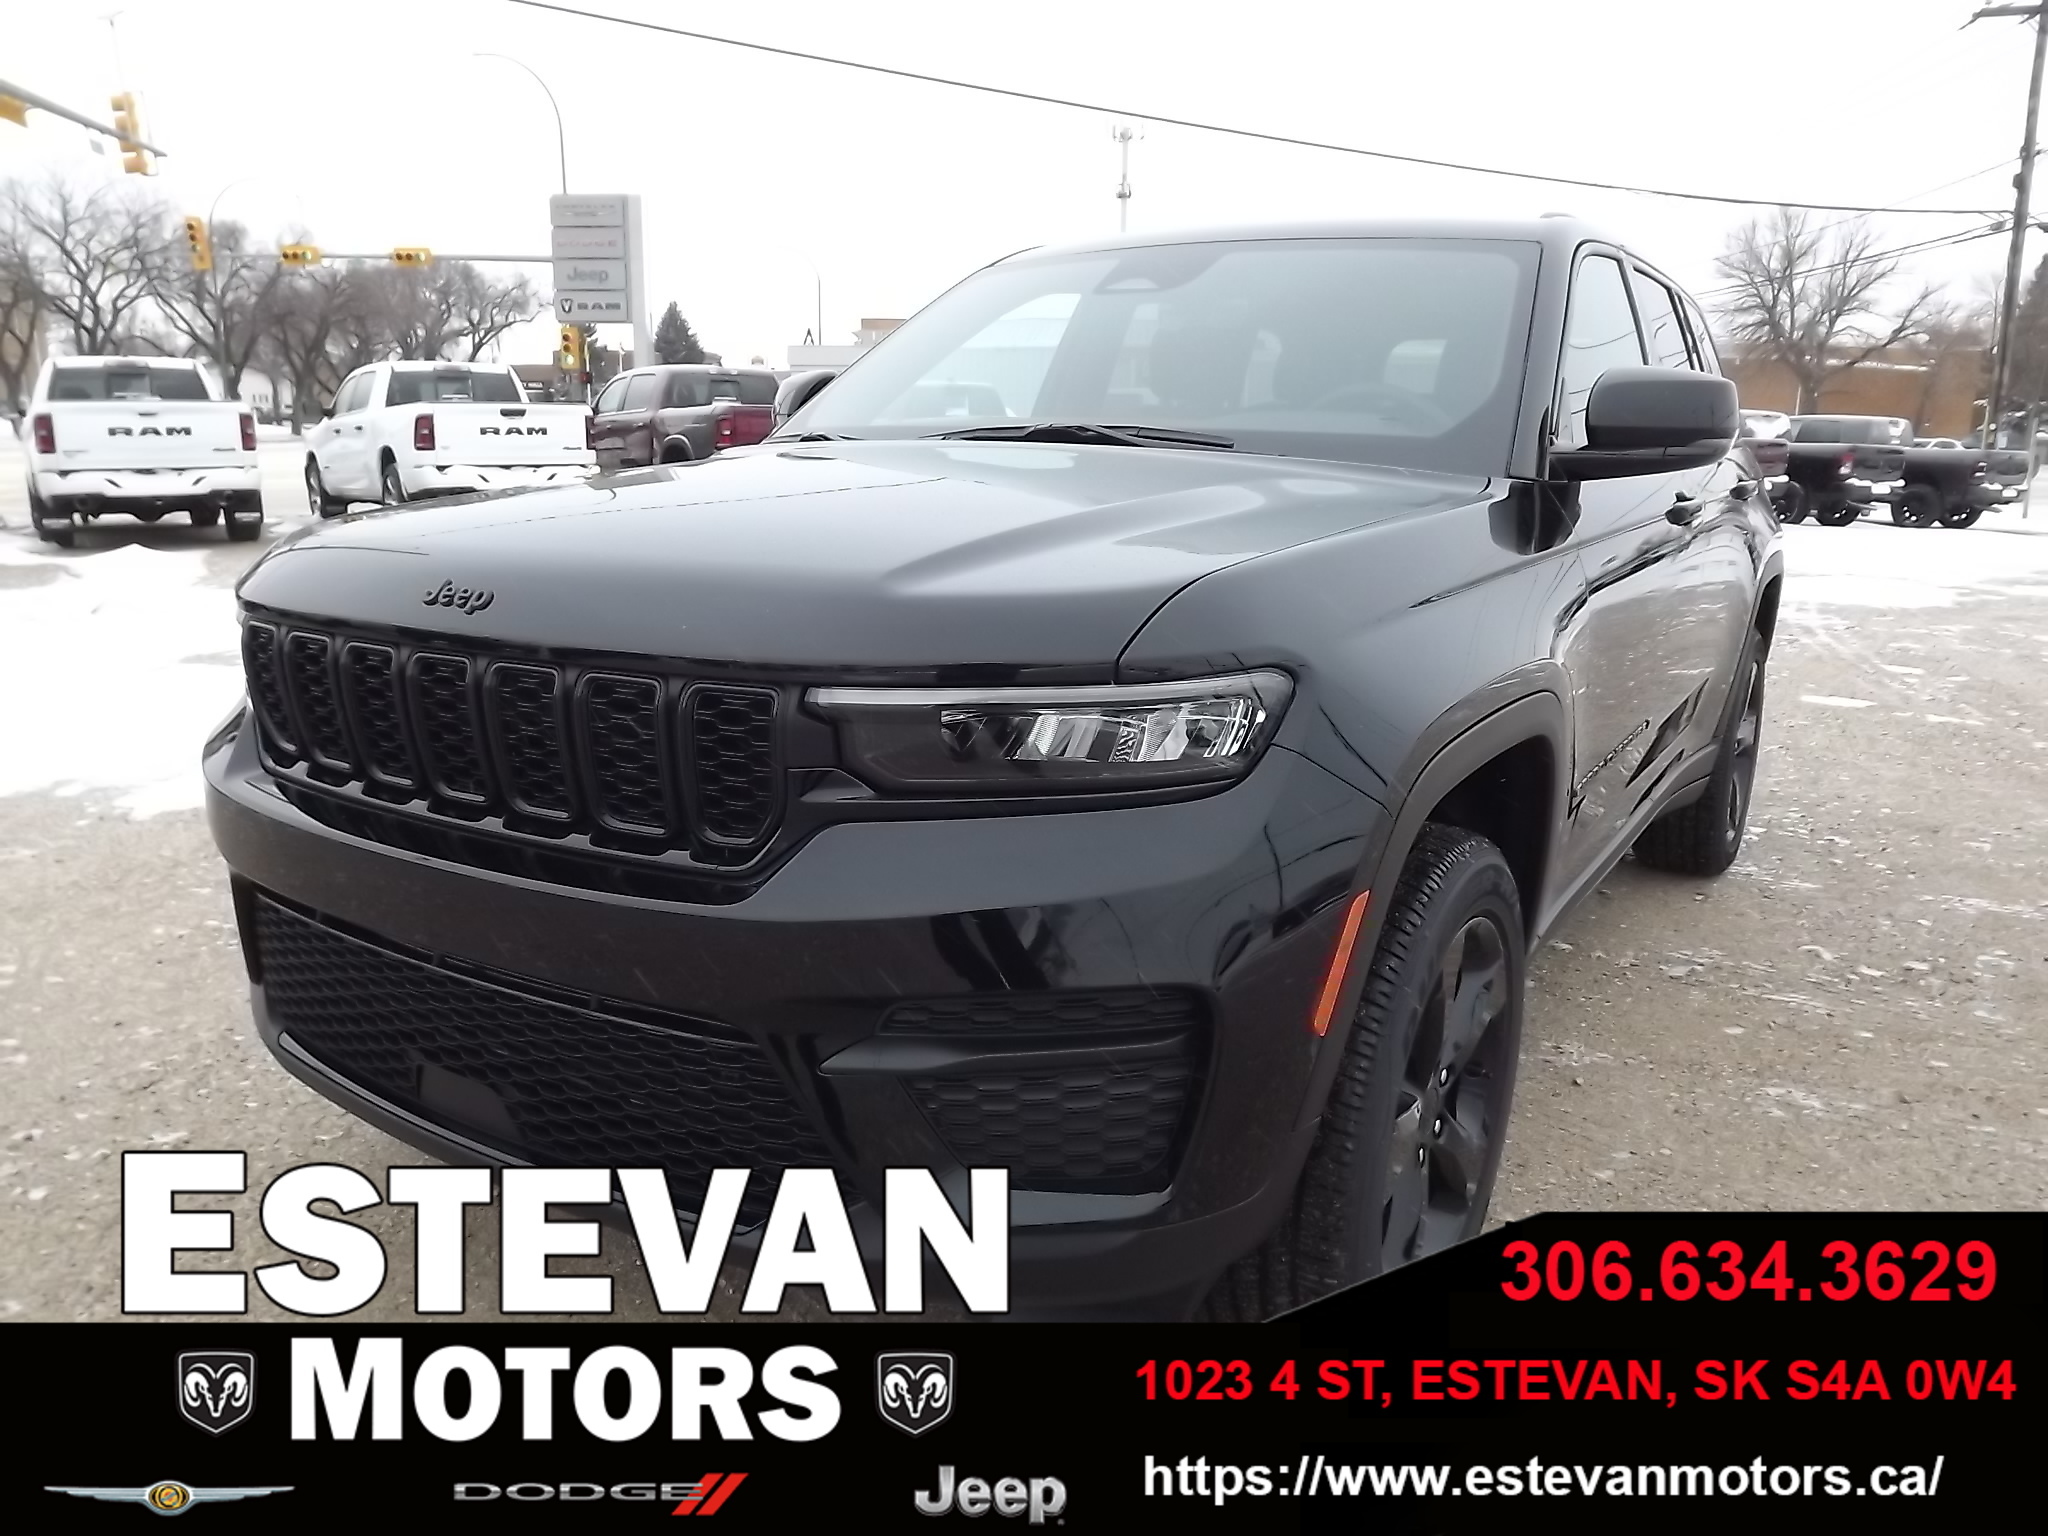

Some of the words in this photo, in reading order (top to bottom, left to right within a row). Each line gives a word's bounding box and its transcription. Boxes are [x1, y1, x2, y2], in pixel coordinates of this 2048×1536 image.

[567, 266, 608, 283] Jeep
[577, 302, 621, 310] RAM
[107, 426, 192, 436] RAM
[479, 426, 548, 436] RAM
[422, 578, 496, 616] Jeep
